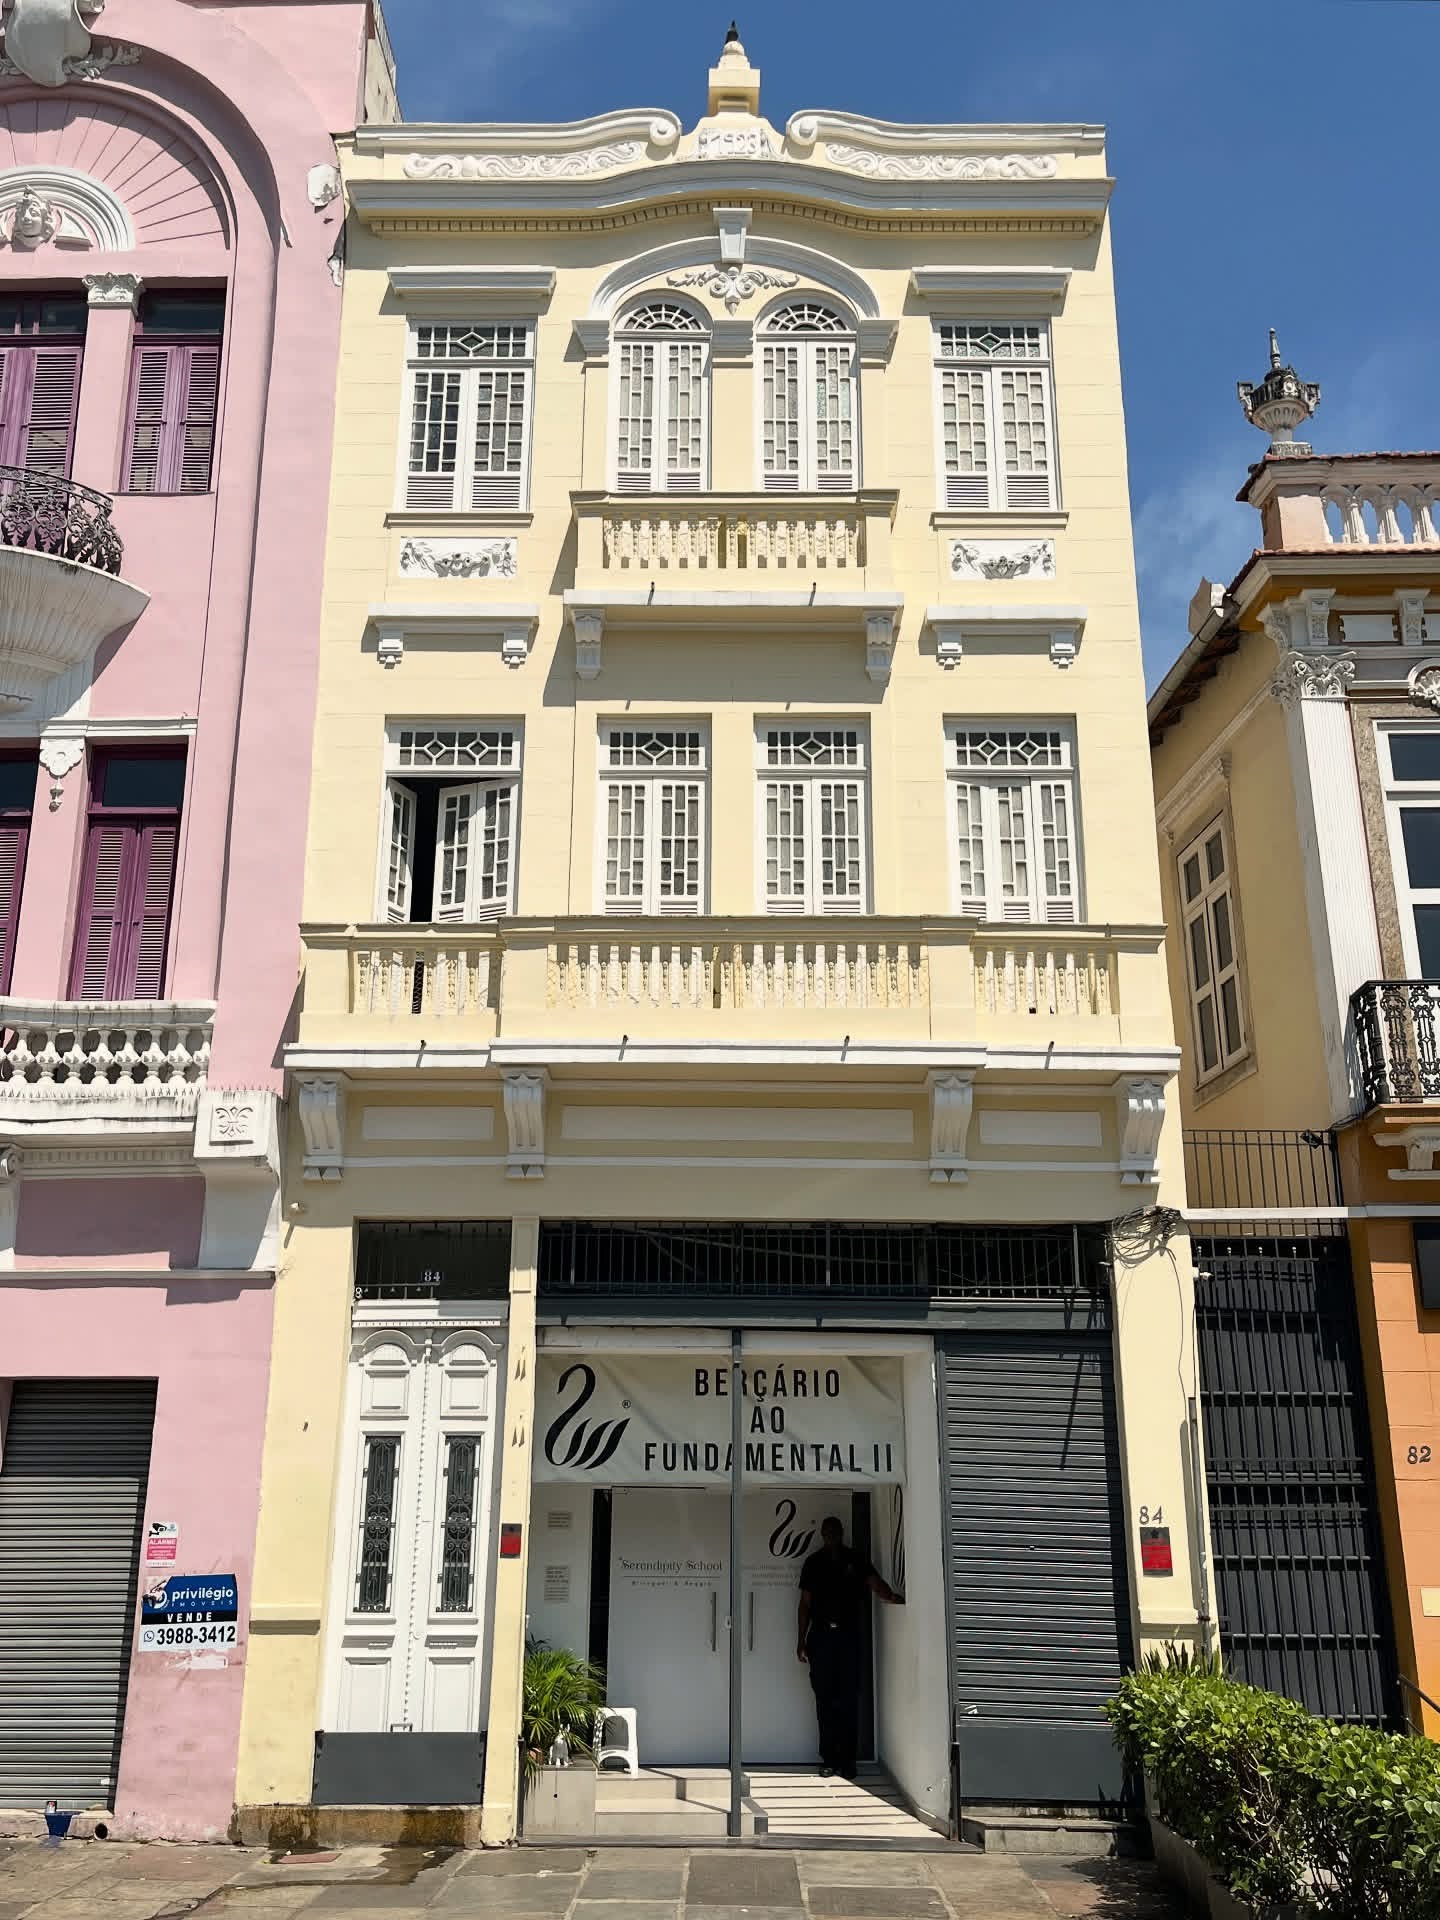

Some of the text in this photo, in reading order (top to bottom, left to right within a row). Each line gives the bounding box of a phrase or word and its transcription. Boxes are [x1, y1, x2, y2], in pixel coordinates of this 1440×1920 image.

[424, 1271, 440, 1282] 84
[750, 1406, 785, 1434] AO
[644, 1442, 893, 1473] FUNDAMENTAL II
[1407, 1445, 1432, 1465] 82
[1139, 1505, 1163, 1525] 84
[686, 1559, 722, 1571] School
[172, 1586, 234, 1602] privilégio
[167, 1611, 212, 1623] VENDE
[156, 1625, 236, 1645] 3988-3412
